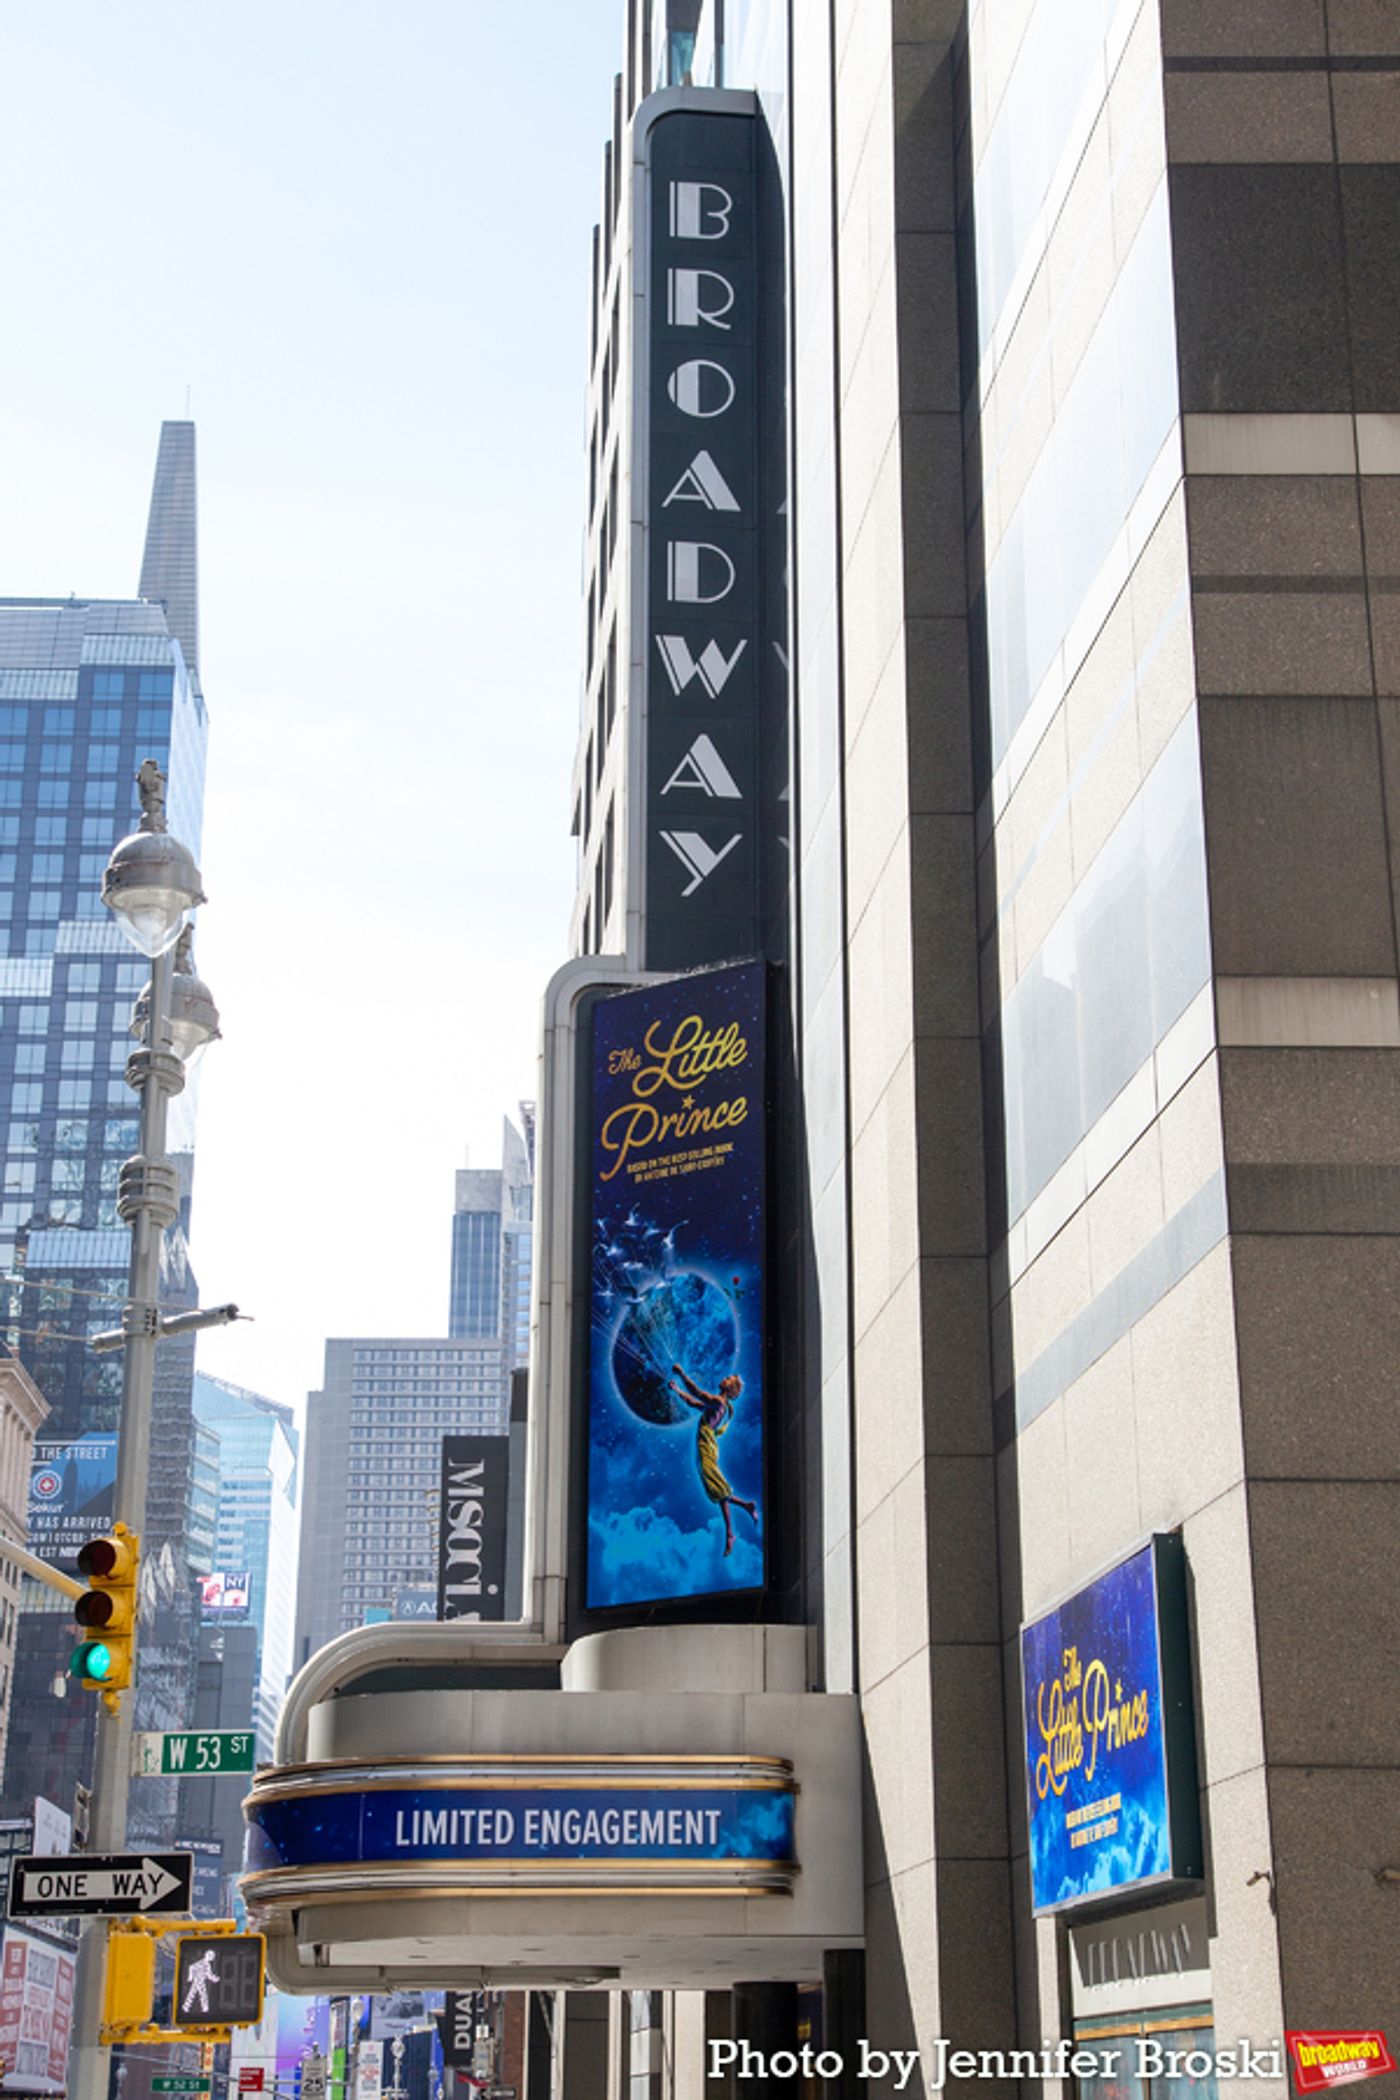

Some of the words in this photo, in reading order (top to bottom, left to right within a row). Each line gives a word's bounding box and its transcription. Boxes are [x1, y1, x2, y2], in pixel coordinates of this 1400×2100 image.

[655, 180, 747, 898] BROADWAY
[608, 1048, 641, 1074] The
[632, 1014, 748, 1097] Little
[600, 1095, 748, 1181] Prince
[41, 1447, 63, 1460] THE
[64, 1447, 108, 1460] STREET
[226, 1576, 243, 1589] NY
[1063, 1645, 1082, 1692] The
[1036, 1679, 1084, 1799] Little
[1082, 1659, 1148, 1782] Prince
[169, 1738, 188, 1770] W
[195, 1736, 221, 1770] 53
[230, 1736, 249, 1754] ST
[396, 1810, 514, 1845] LIMITED
[524, 1809, 721, 1846] ENGAGEMENT
[37, 1874, 87, 1898] ONE
[112, 1873, 164, 1896] WAY
[303, 2078, 323, 2092] 25
